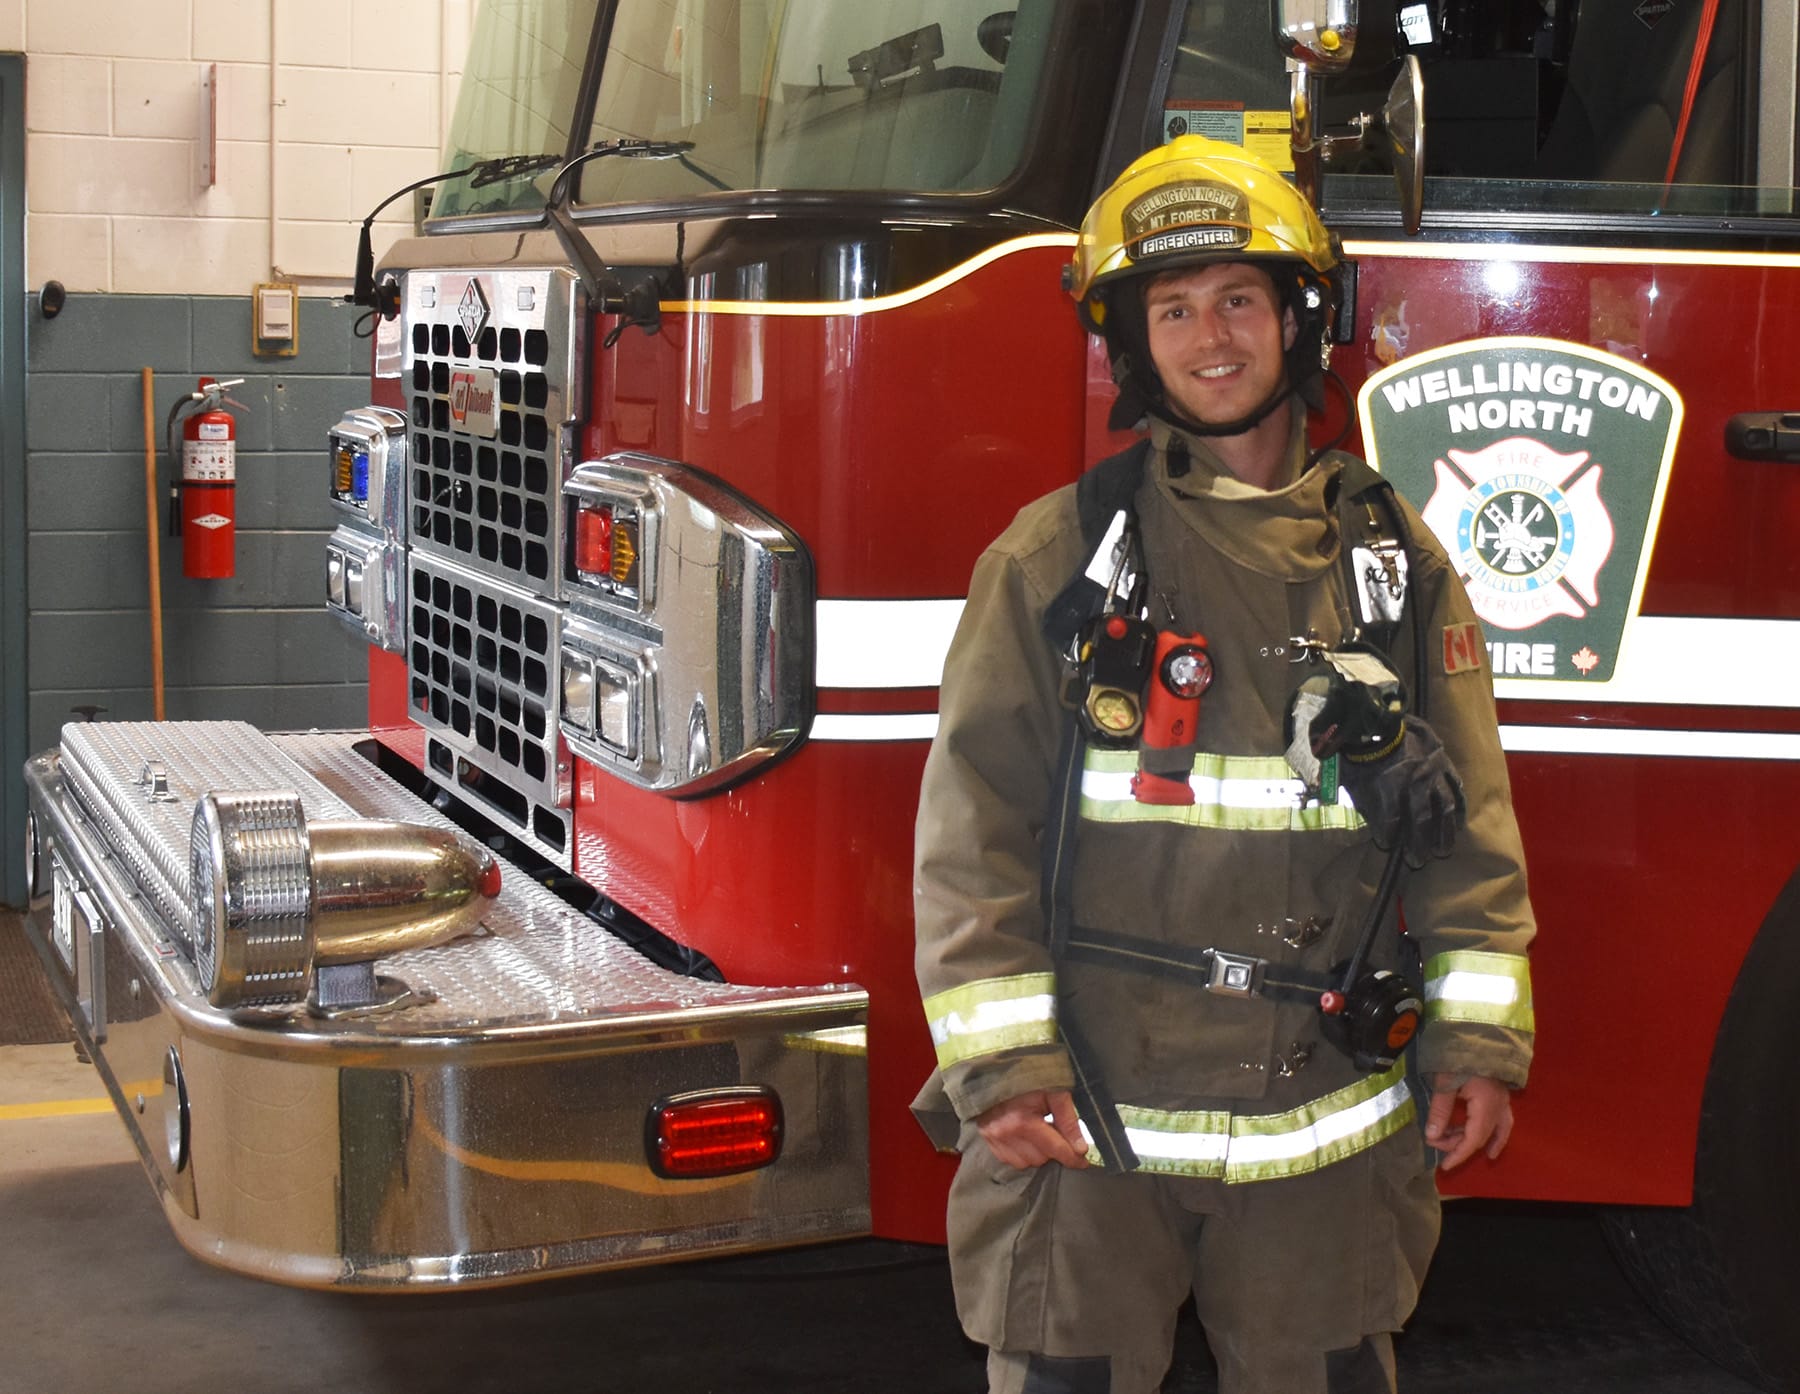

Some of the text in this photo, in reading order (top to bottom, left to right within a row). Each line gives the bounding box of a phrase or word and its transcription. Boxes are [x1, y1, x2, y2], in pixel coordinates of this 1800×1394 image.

[1132, 187, 1238, 220] WELLINGTON NORTH
[1171, 207, 1217, 224] FOREST
[1145, 232, 1233, 253] FIREFIGHTER
[1382, 362, 1661, 422] WELLINGTON
[1448, 399, 1593, 437] NORTH
[1497, 452, 1544, 467] FIRE
[1472, 592, 1553, 612] SERVICE
[1486, 643, 1556, 676] IRE
